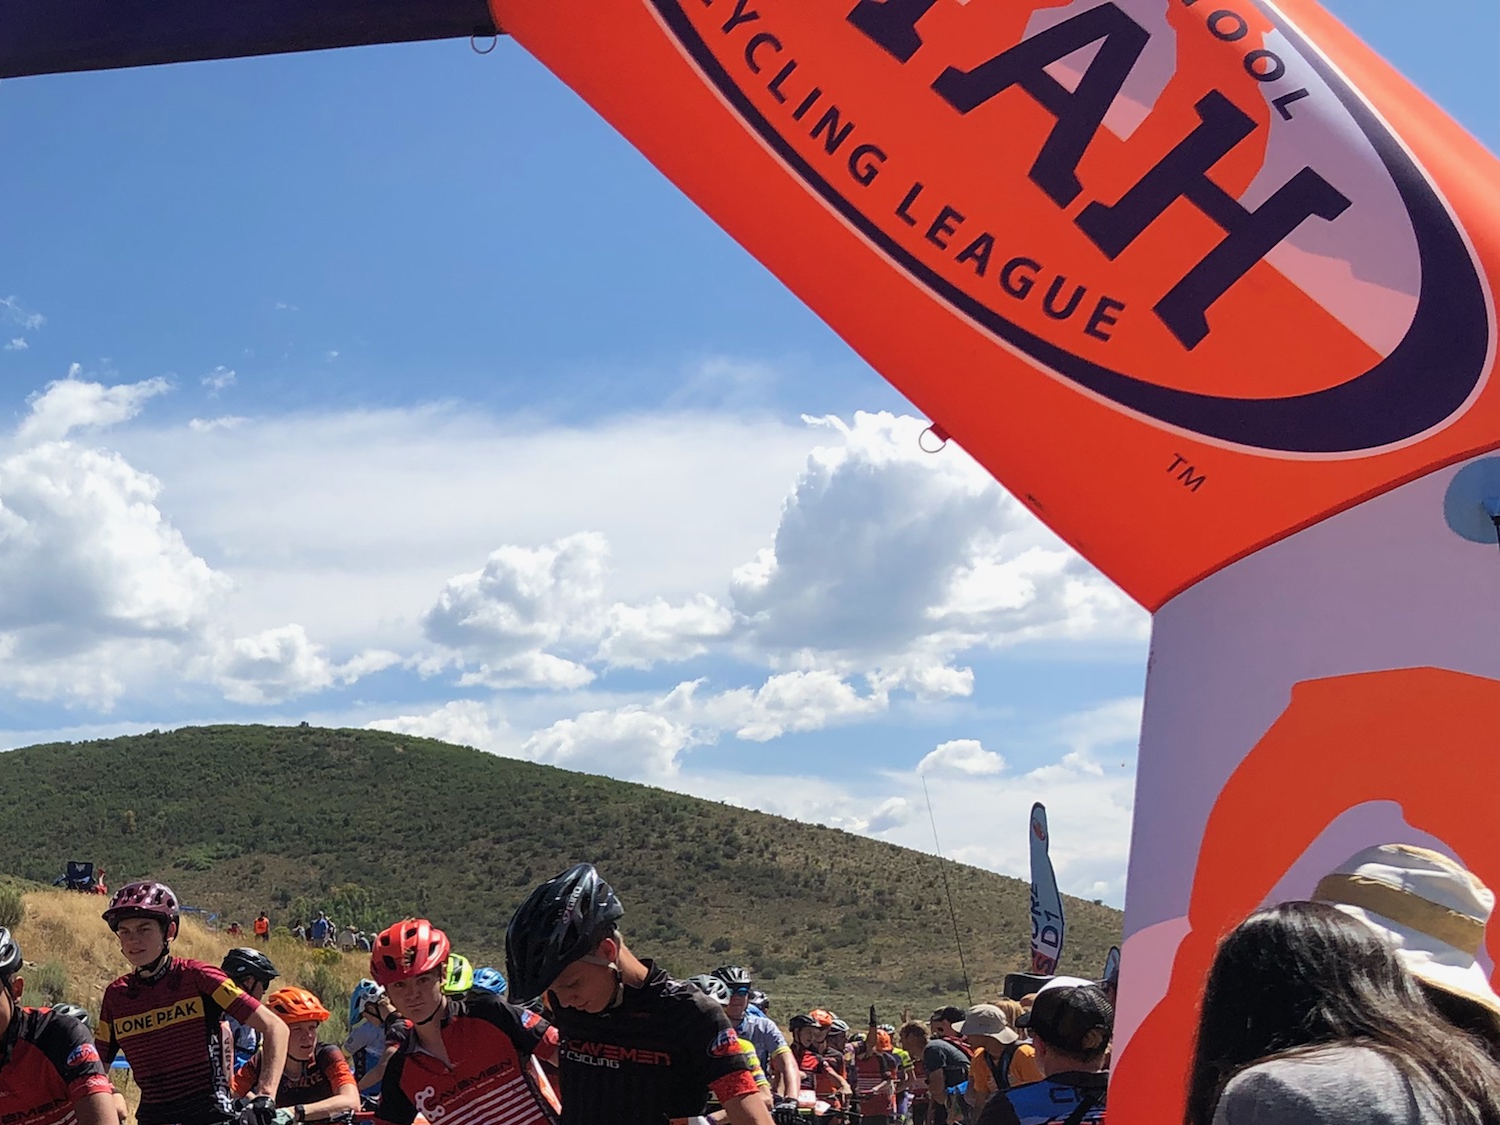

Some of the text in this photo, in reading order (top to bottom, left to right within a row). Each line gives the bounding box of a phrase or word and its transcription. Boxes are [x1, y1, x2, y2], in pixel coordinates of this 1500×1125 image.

[1186, 0, 1309, 121] OOL
[702, 0, 1126, 343] YCLING LEAGUE
[1166, 453, 1206, 492] TM
[115, 1002, 198, 1035] LONE PEAK
[566, 1051, 620, 1069] CYCLING
[568, 1038, 672, 1067] CAVEMEN
